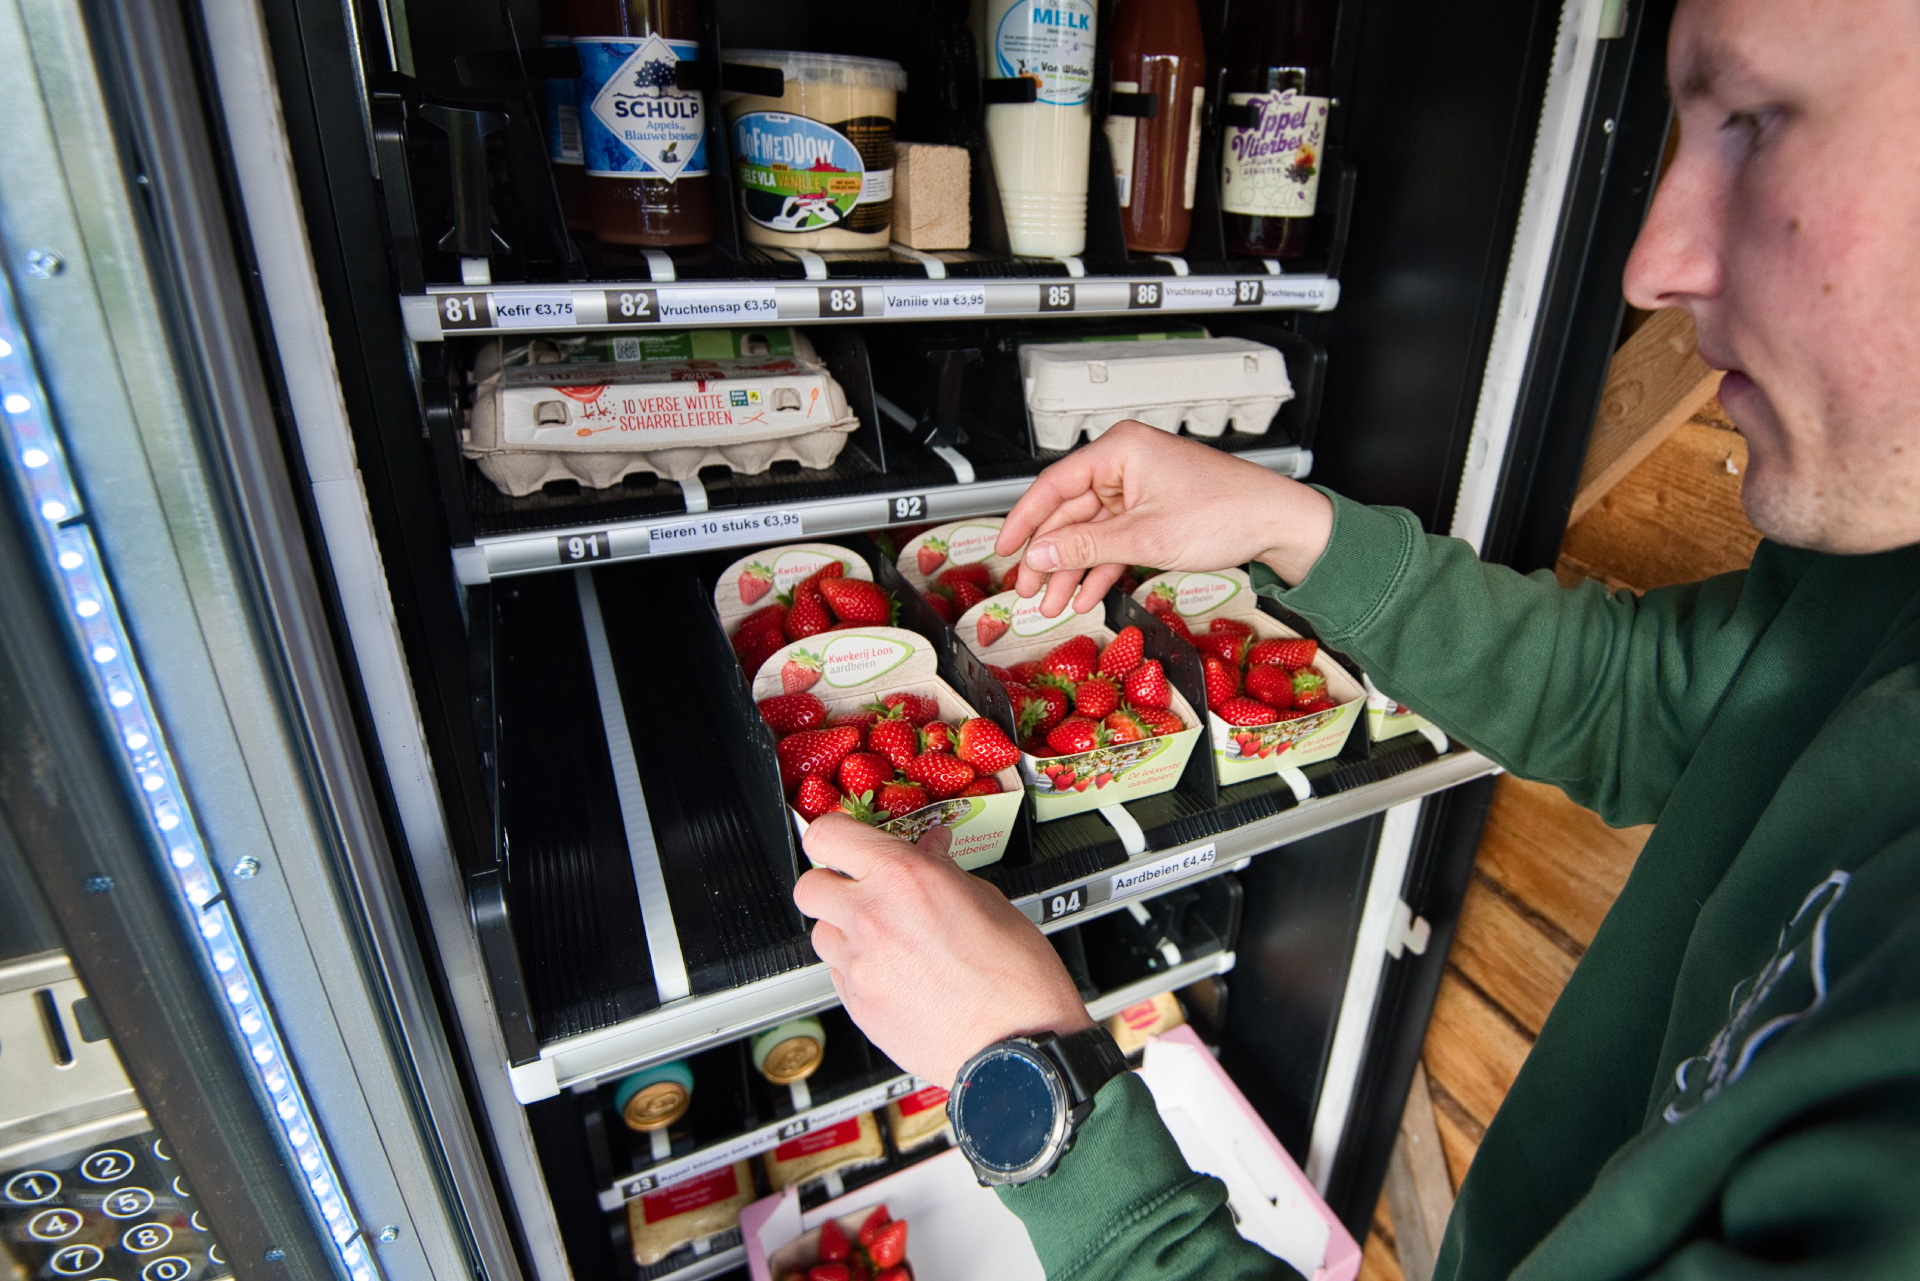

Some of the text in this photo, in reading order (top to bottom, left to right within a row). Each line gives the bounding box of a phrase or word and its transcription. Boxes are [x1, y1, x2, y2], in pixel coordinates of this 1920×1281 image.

[1033, 8, 1090, 31] MELK
[614, 101, 699, 119] SCHULP
[646, 120, 680, 131] Appels
[624, 130, 699, 141] Blauwe bessen
[757, 170, 776, 187] VLA
[778, 174, 820, 190] VANILLE
[830, 289, 857, 312] 83
[953, 294, 984, 307] €3,95
[1048, 286, 1071, 307] 85
[1137, 284, 1158, 304] 86
[1165, 286, 1237, 298] Vruchtensap €3,50
[1238, 282, 1259, 302] 87
[446, 297, 477, 322] 81
[496, 303, 573, 317] Kefir €3,75
[619, 293, 650, 316] 82
[660, 299, 777, 317] Vruchtensap €3,50
[622, 394, 725, 415] 10 VERSE WITTE
[619, 410, 733, 432] SCHARRELEIEREN
[895, 498, 922, 518] 92
[650, 514, 799, 541] Eieren 10 stuks €3,95
[983, 534, 998, 542] Loo
[567, 535, 600, 560] 91
[778, 562, 813, 575] Kwekerij
[1180, 583, 1227, 596] Kwekerij Loos
[828, 647, 894, 664] Kwekerij Loos
[830, 659, 876, 674] aardbeien
[1142, 762, 1181, 777] lekkerste
[1128, 771, 1176, 788] aardbeien!
[954, 830, 1004, 846] lekkerste
[948, 840, 999, 858] ardbeien!
[1115, 850, 1214, 891] Aardbeien €4,45
[1052, 890, 1081, 918] 94
[893, 1080, 911, 1095] 45
[785, 1121, 805, 1137] 44
[95, 1157, 122, 1177] 2
[24, 1178, 44, 1197] 1
[629, 1177, 652, 1195] 43
[118, 1193, 140, 1212] 5
[45, 1214, 68, 1233] 4
[137, 1229, 159, 1247] 8
[64, 1249, 85, 1270] 7
[156, 1262, 178, 1280] 0
